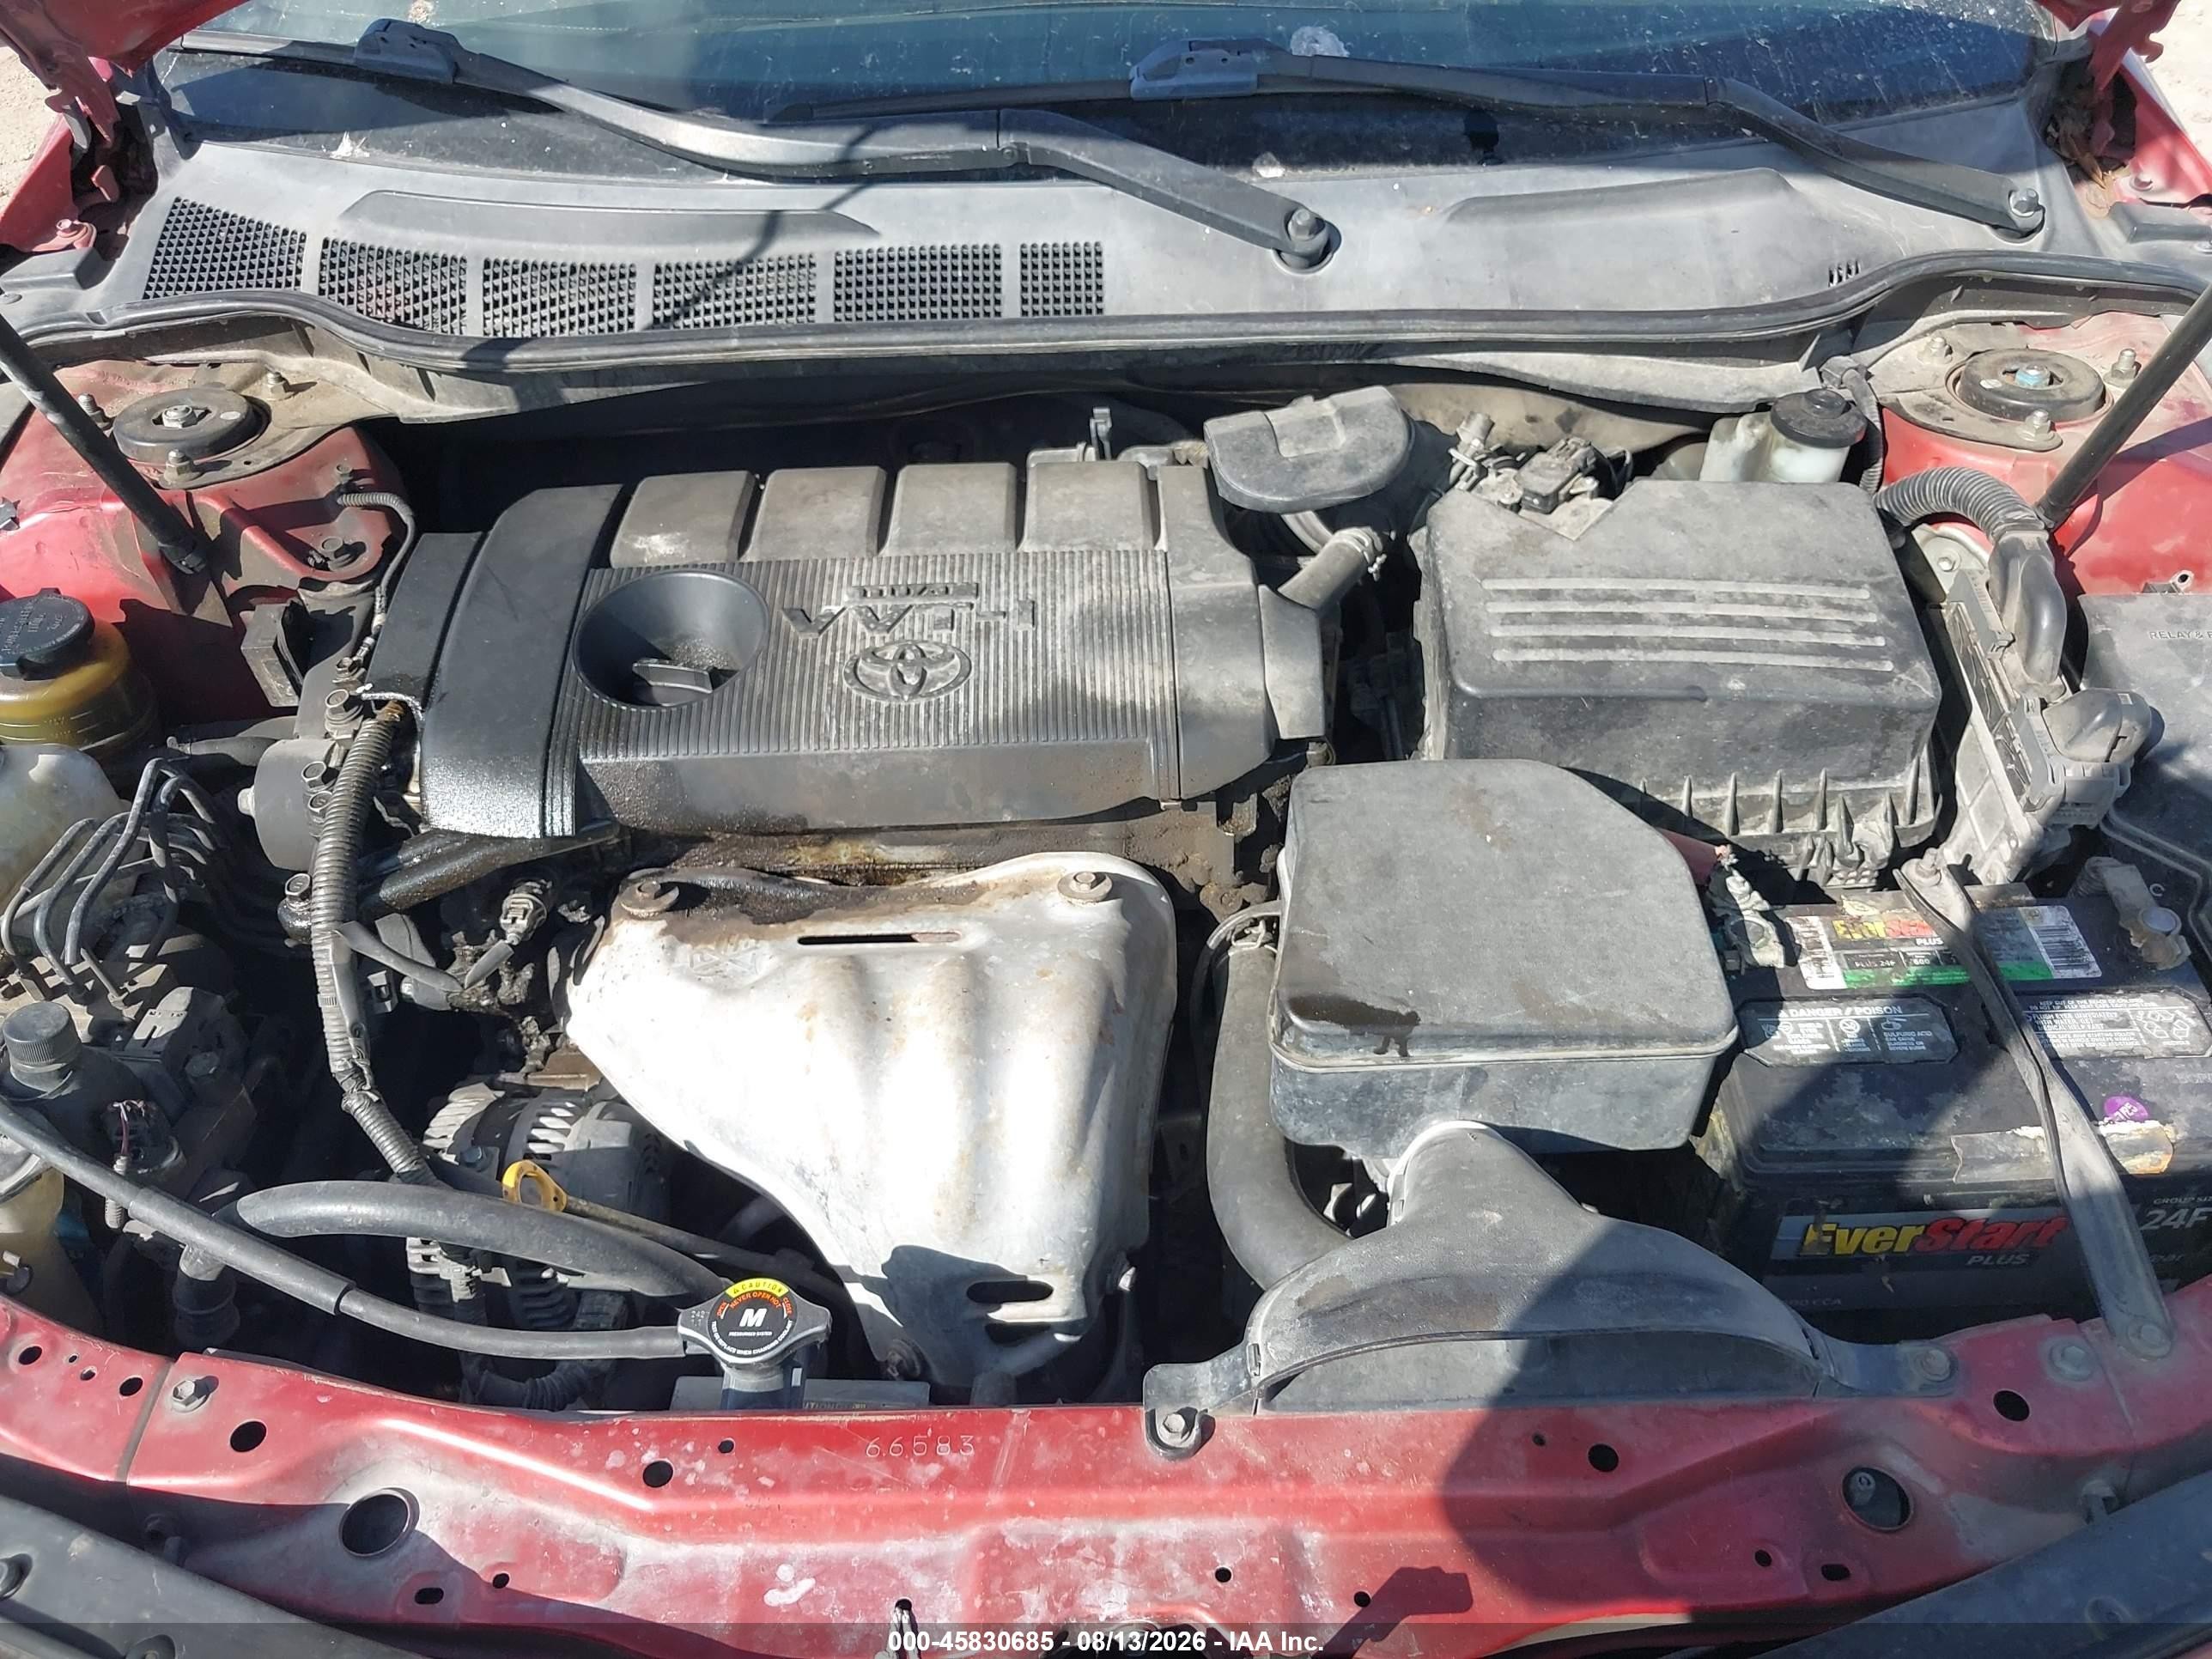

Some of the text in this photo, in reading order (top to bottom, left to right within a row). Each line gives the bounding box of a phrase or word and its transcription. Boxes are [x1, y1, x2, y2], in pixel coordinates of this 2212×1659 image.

[2149, 630, 2191, 640] RELAY
[2194, 630, 2203, 639] &
[1916, 937, 1944, 946] PLUS
[1790, 1006, 1903, 1018] DANGER / POISON
[2139, 1206, 2212, 1230] 24F
[1799, 1214, 2069, 1256] EverStart
[1966, 1253, 2030, 1266] PLUS
[741, 1281, 783, 1293] CAUTION
[729, 1291, 782, 1310] NEVER OPEN HOT
[782, 1296, 793, 1316] CLOSE
[738, 1308, 768, 1328] M
[866, 1435, 975, 1458] 66583
